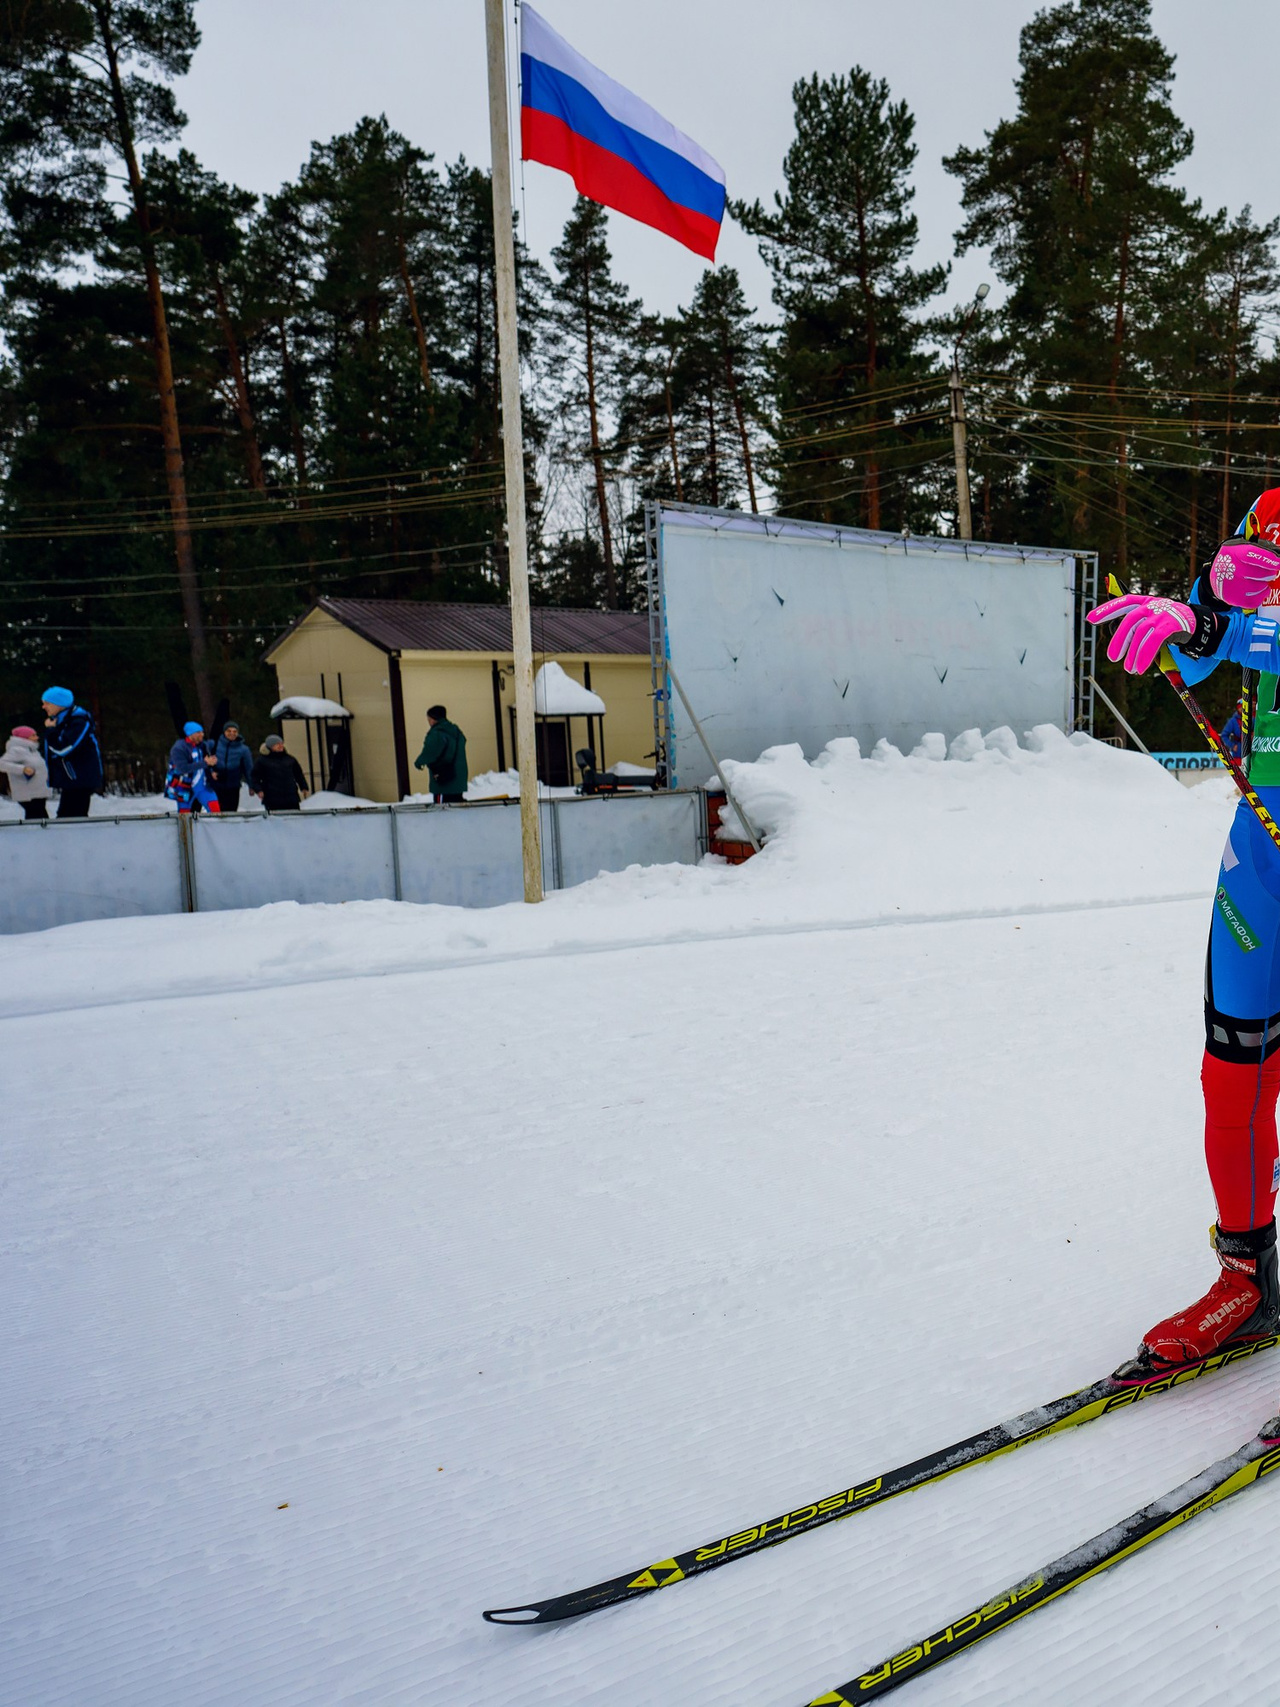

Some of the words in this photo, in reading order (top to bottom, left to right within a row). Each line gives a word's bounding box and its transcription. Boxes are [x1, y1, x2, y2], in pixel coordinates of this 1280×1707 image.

[1195, 616, 1211, 652] LEKI
[1155, 757, 1219, 769] СПОРТ
[1198, 1290, 1253, 1332] alpina
[1101, 1337, 1279, 1415] FISCHER
[695, 1477, 882, 1562] FISCHER
[857, 1576, 1045, 1690] FISCHER
